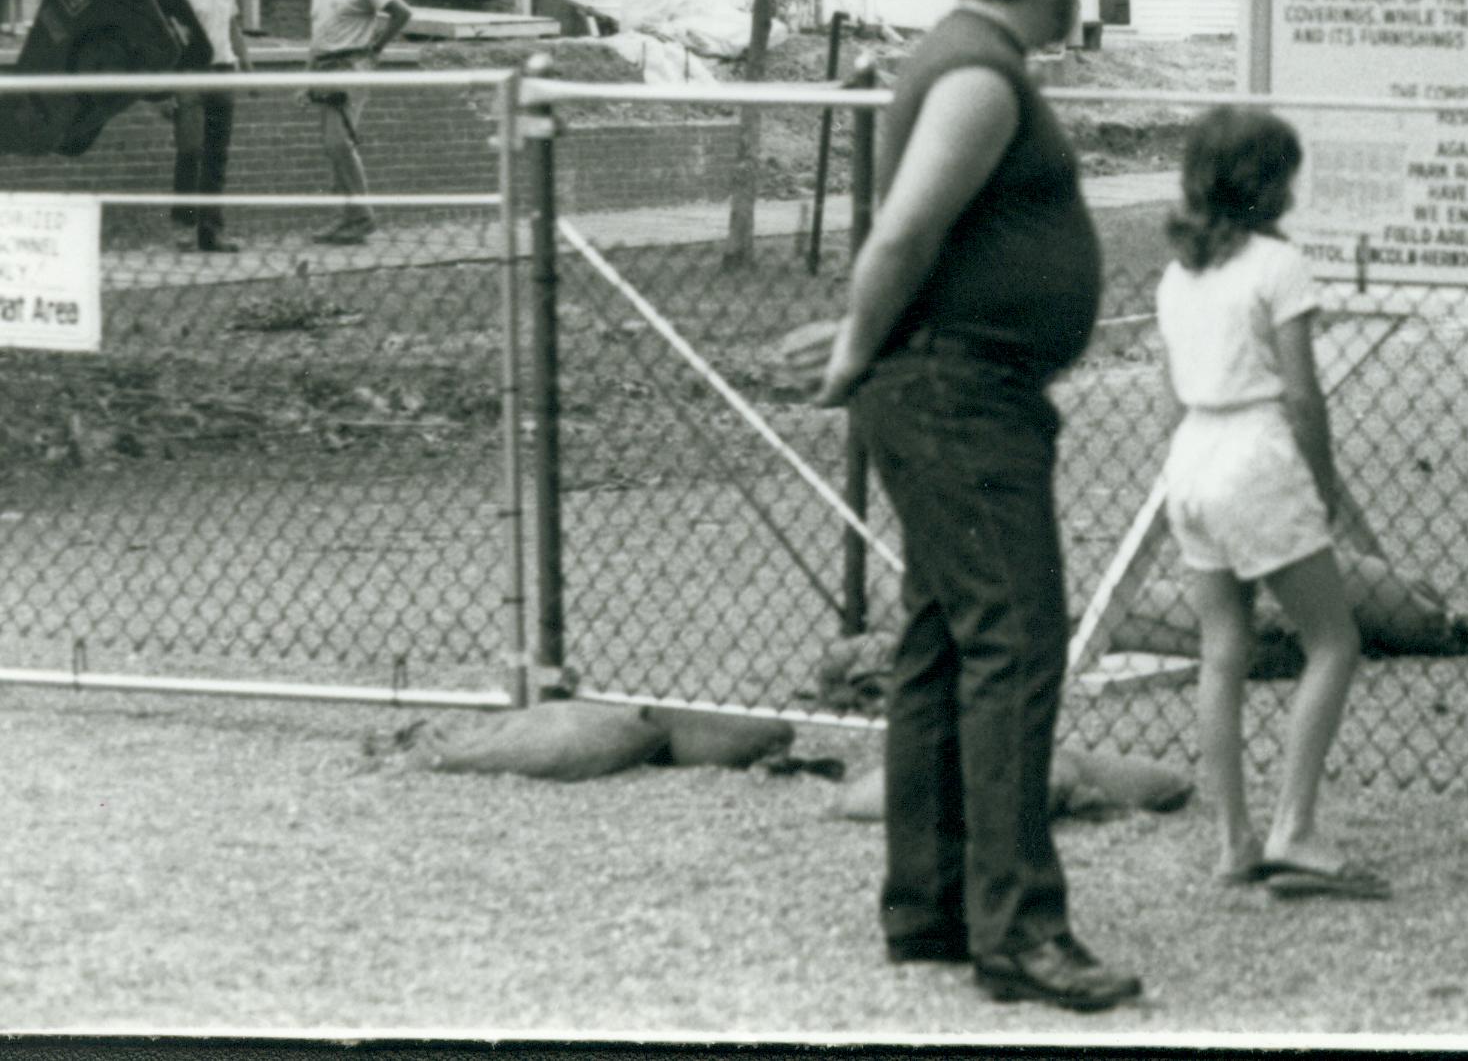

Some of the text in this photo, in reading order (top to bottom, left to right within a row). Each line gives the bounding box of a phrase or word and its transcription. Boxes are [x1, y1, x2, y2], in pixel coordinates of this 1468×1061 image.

[1382, 8, 1433, 26] WHILE
[1293, 27, 1325, 45] AND
[1408, 162, 1448, 180] PARK
[1428, 184, 1466, 202] HAVE
[1383, 225, 1433, 245] FIELD
[31, 296, 79, 325] Area
